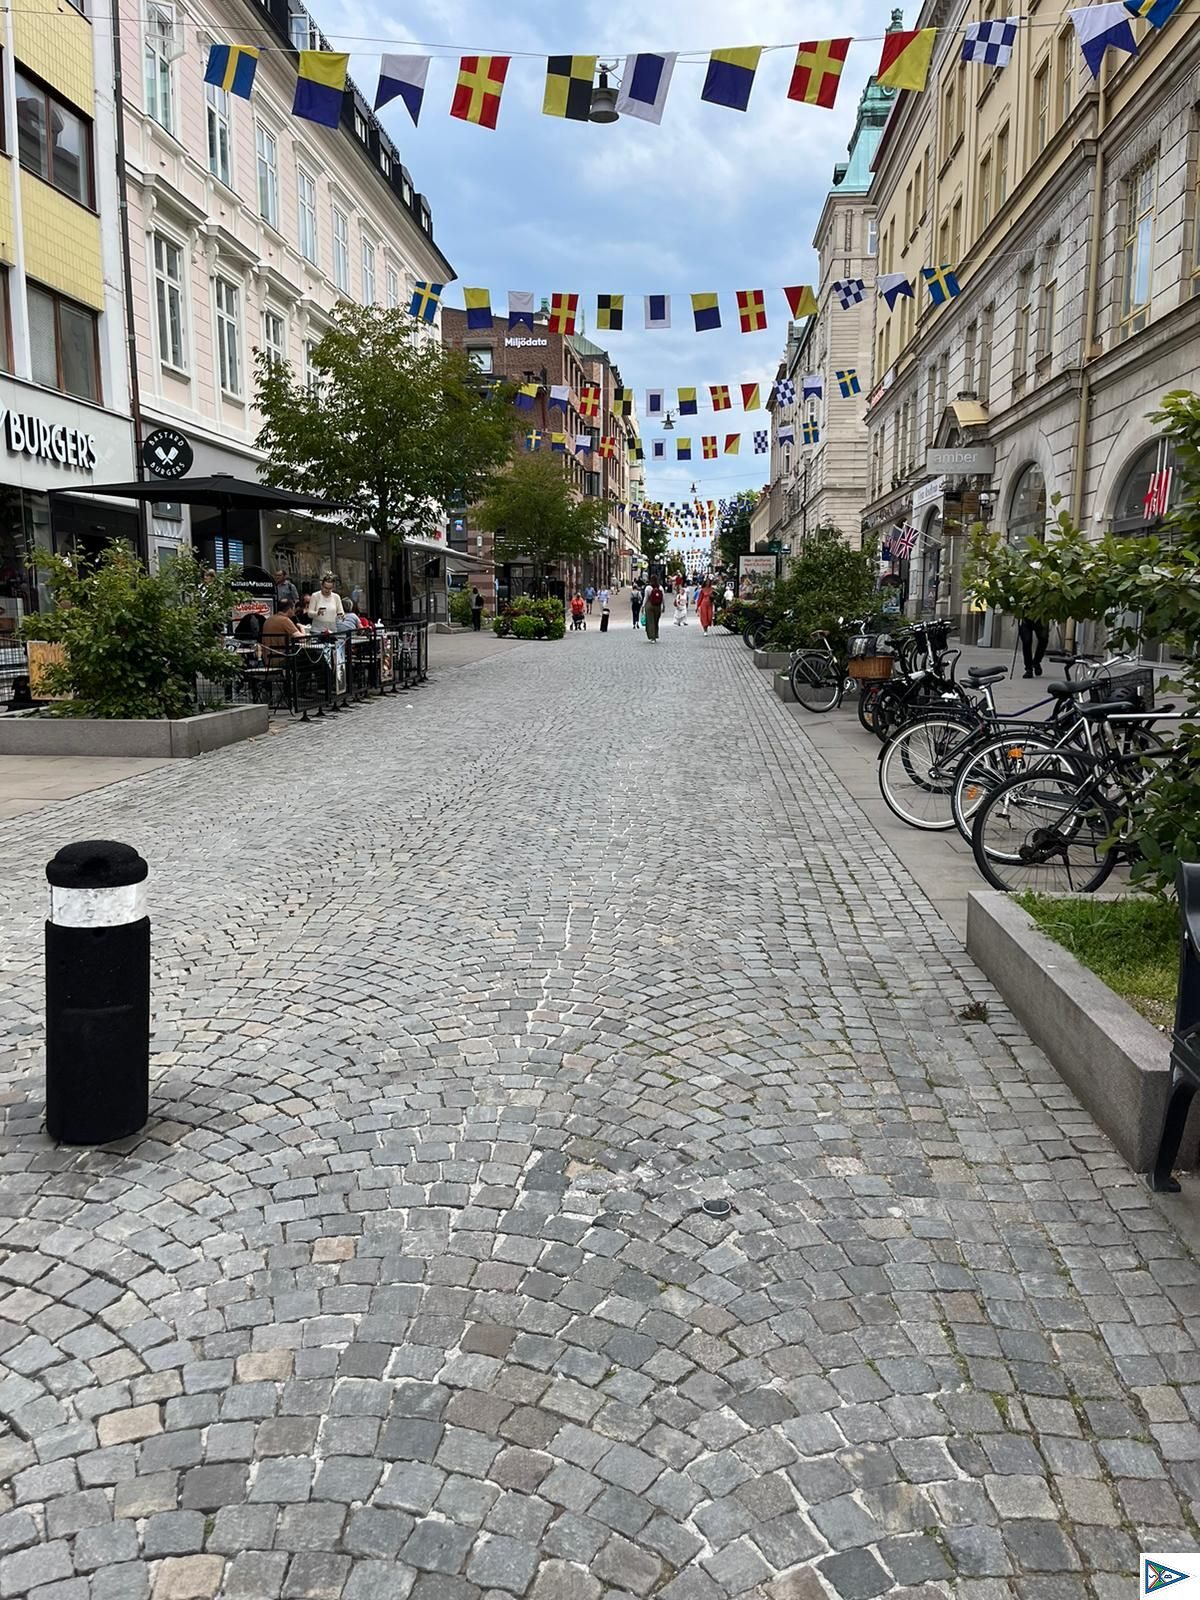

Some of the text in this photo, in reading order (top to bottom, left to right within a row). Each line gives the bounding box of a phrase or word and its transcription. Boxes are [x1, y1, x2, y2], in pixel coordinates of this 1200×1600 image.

[505, 337, 547, 348] Miljödata
[8, 409, 98, 470] BURGERS
[148, 431, 184, 446] BASTARD
[934, 452, 978, 463] amber
[150, 462, 185, 476] BURGERS
